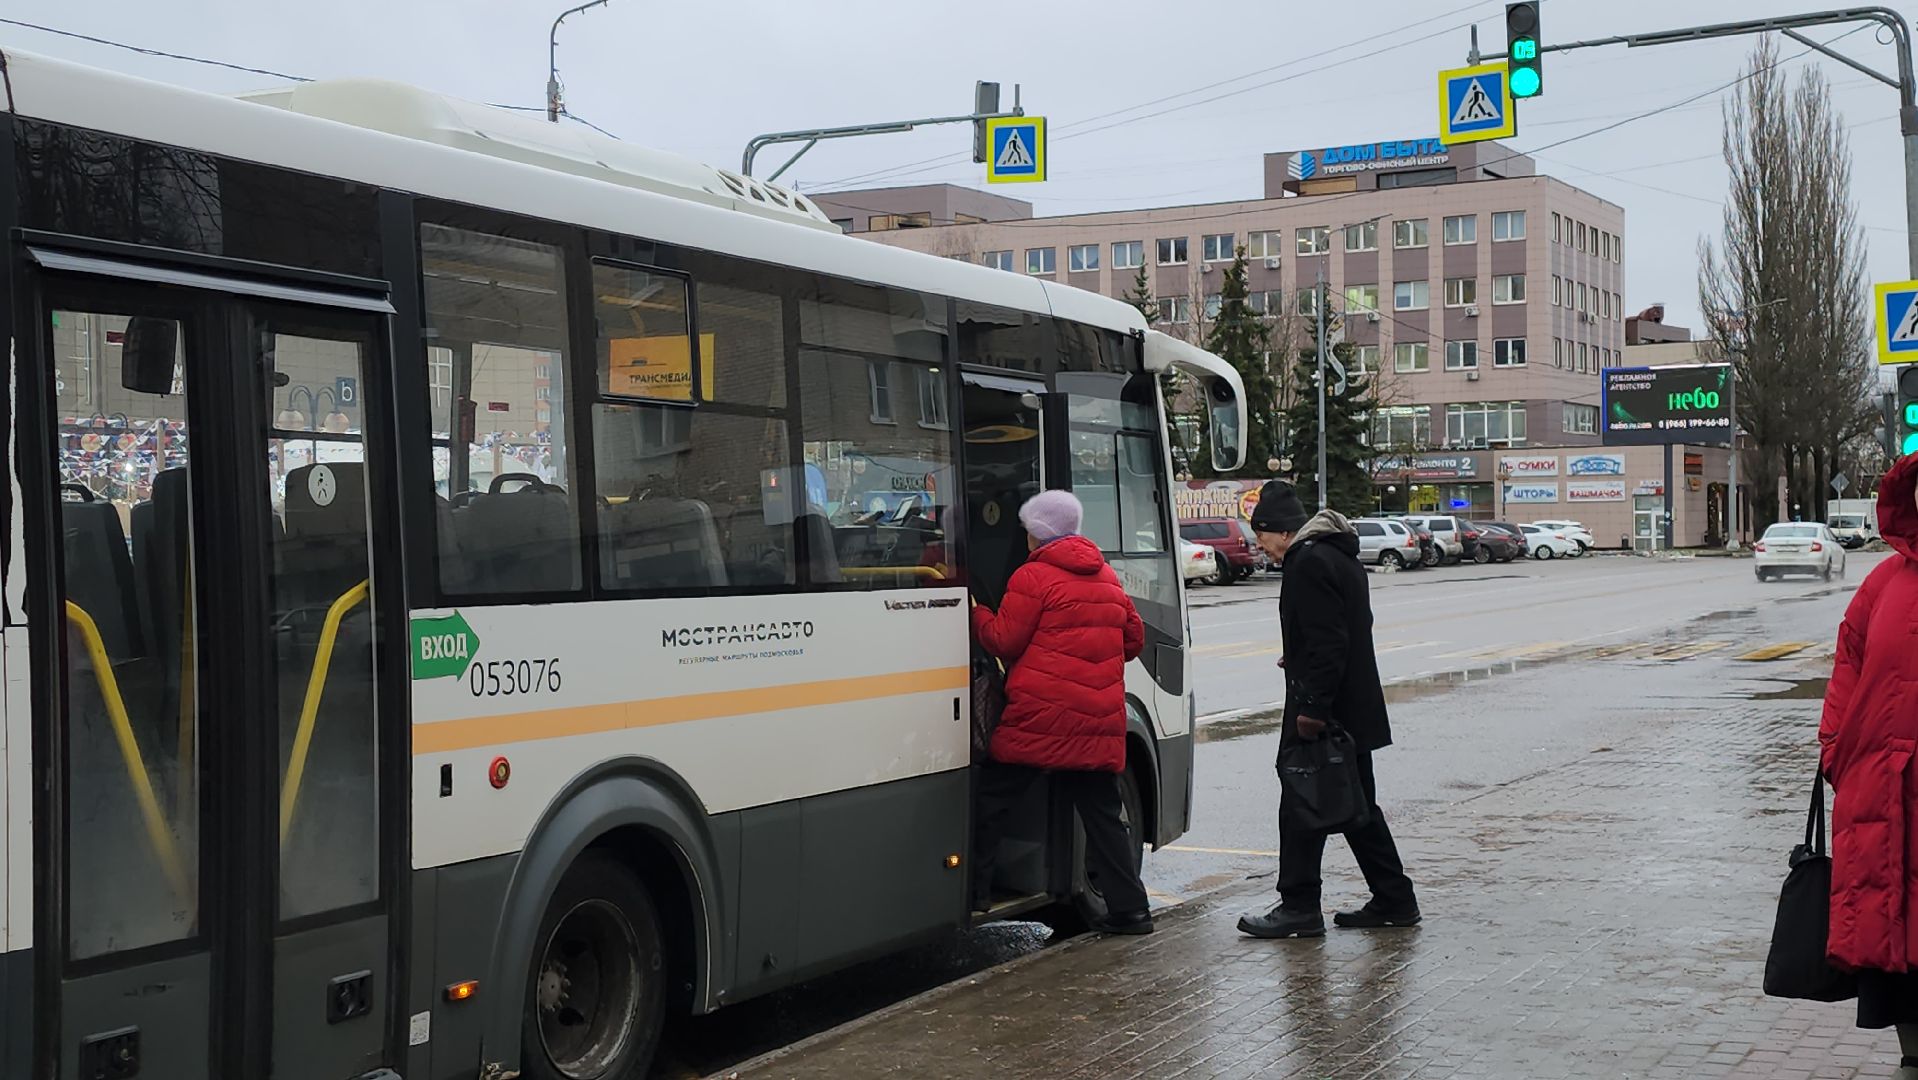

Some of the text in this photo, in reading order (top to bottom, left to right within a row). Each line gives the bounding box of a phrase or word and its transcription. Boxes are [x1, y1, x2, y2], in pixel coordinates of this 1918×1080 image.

[1321, 138, 1448, 165] ДОМ БЫТА
[1323, 155, 1449, 175] ТОРГОВО-ОФИСНЫЙ ЦЕНТР
[1610, 382, 1652, 391] АГЕНТСТВО
[1668, 387, 1720, 411] небо
[1462, 457, 1471, 470] 2
[1518, 460, 1556, 471] СУМКИ
[1513, 488, 1556, 498] ШТОРЫ
[662, 621, 814, 648] МОСТРАНСАВТО
[421, 633, 469, 660] ВХОД
[470, 657, 562, 698] 053076
